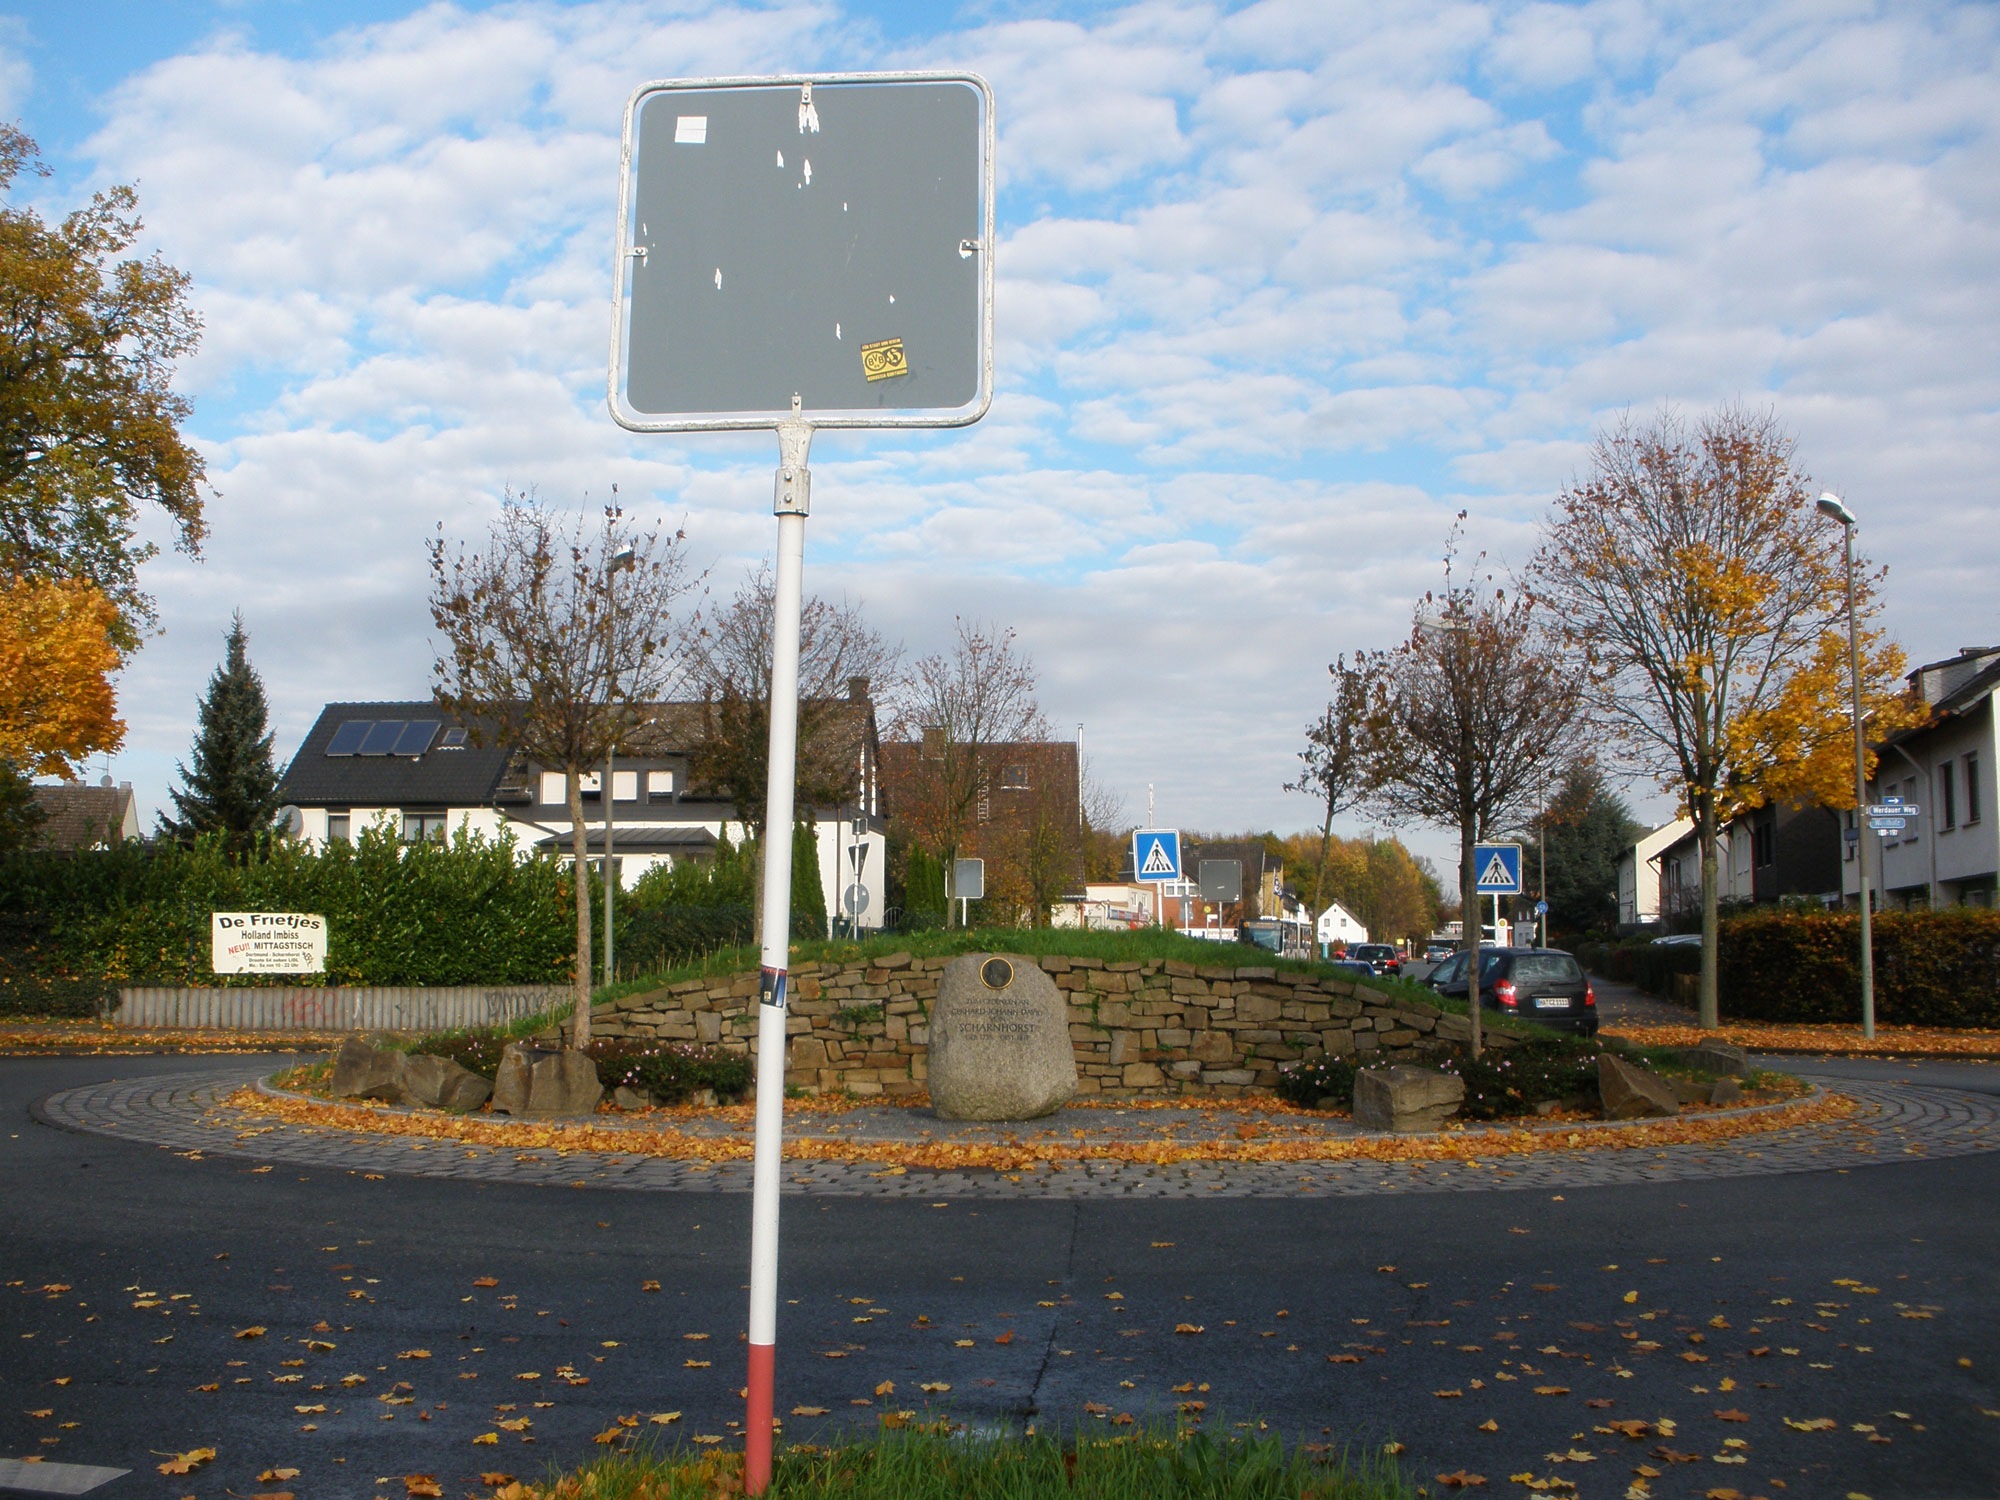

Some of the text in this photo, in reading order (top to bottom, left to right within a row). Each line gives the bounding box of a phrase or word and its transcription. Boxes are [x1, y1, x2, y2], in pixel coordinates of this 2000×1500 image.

[868, 353, 884, 366] BVB
[1873, 806, 1916, 815] Werdauer Weg
[219, 914, 321, 930] De Frietjes
[241, 930, 299, 940] Holland Imbiss
[228, 942, 314, 955] NEU!! MITTAGSTISCH
[959, 1023, 1035, 1032] SCHARNHORST
